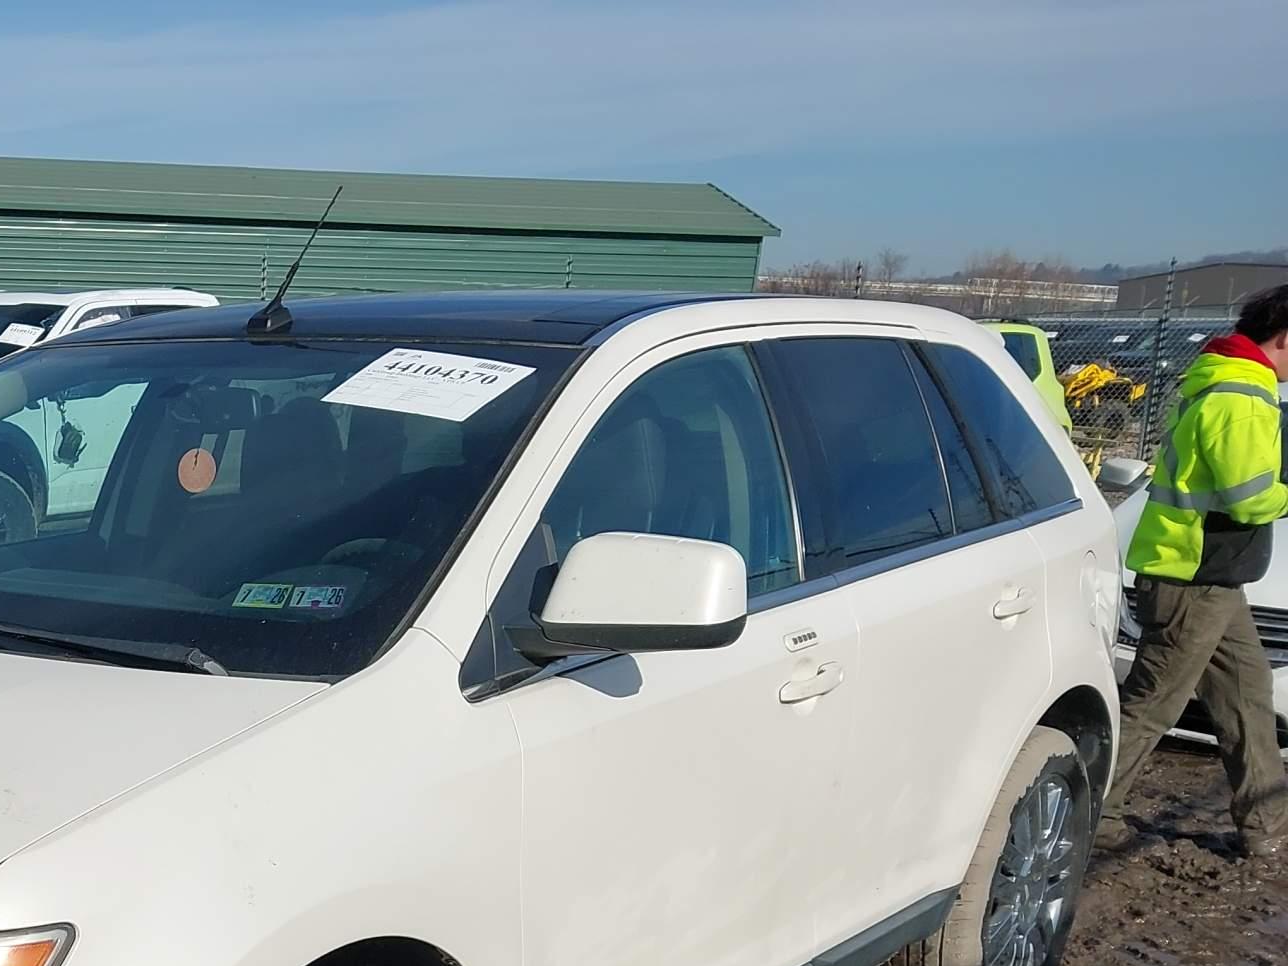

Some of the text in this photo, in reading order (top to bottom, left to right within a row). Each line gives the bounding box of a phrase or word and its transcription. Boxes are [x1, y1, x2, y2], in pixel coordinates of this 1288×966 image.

[383, 360, 499, 385] 44104370
[270, 588, 289, 604] 26
[327, 588, 344, 605] 26
